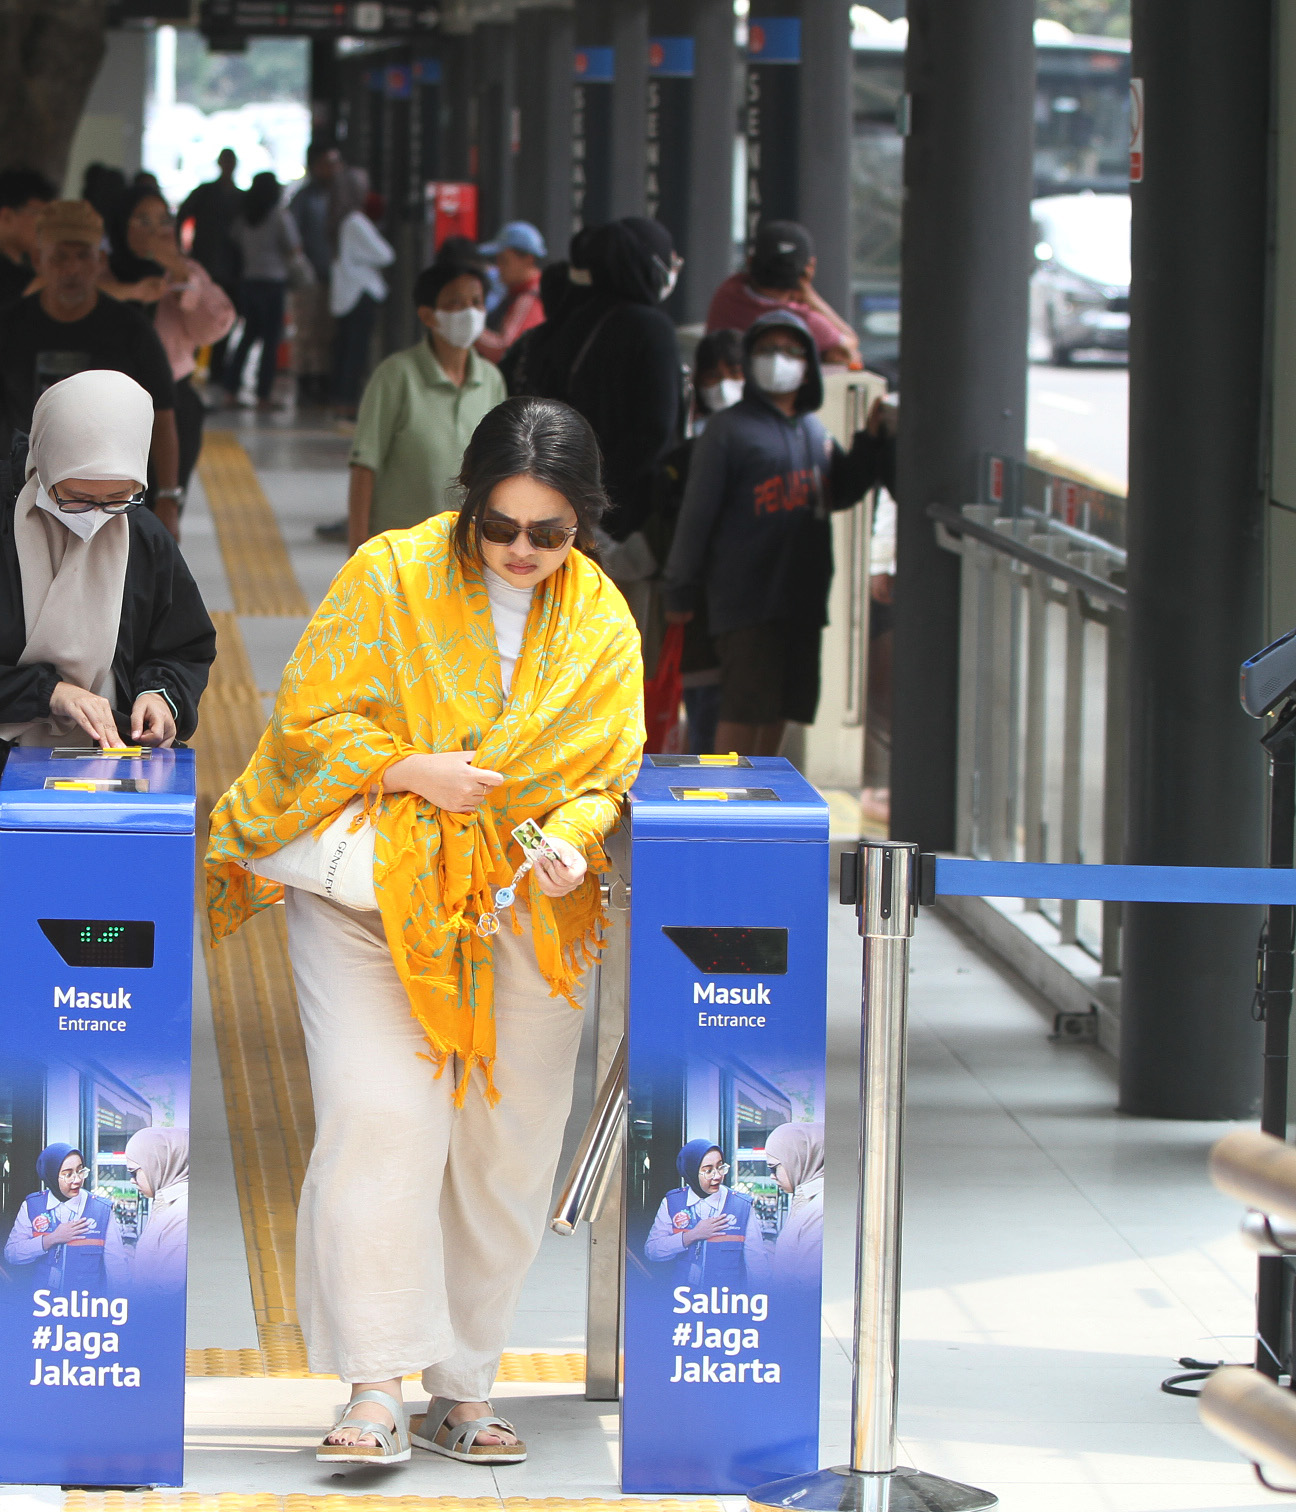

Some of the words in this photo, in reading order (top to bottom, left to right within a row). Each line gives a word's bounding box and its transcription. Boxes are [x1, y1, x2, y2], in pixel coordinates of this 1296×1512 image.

[54, 986, 132, 1009] Masuk
[693, 982, 771, 1005] Masuk
[59, 1016, 127, 1032] Entrance
[698, 1012, 766, 1027] Entrance
[32, 1289, 128, 1326] Saling
[673, 1286, 768, 1321] Saling
[32, 1325, 119, 1359] #Jaga
[672, 1321, 759, 1356] #Jaga
[30, 1359, 141, 1387] Jakarta
[670, 1356, 781, 1383] Jakarta
